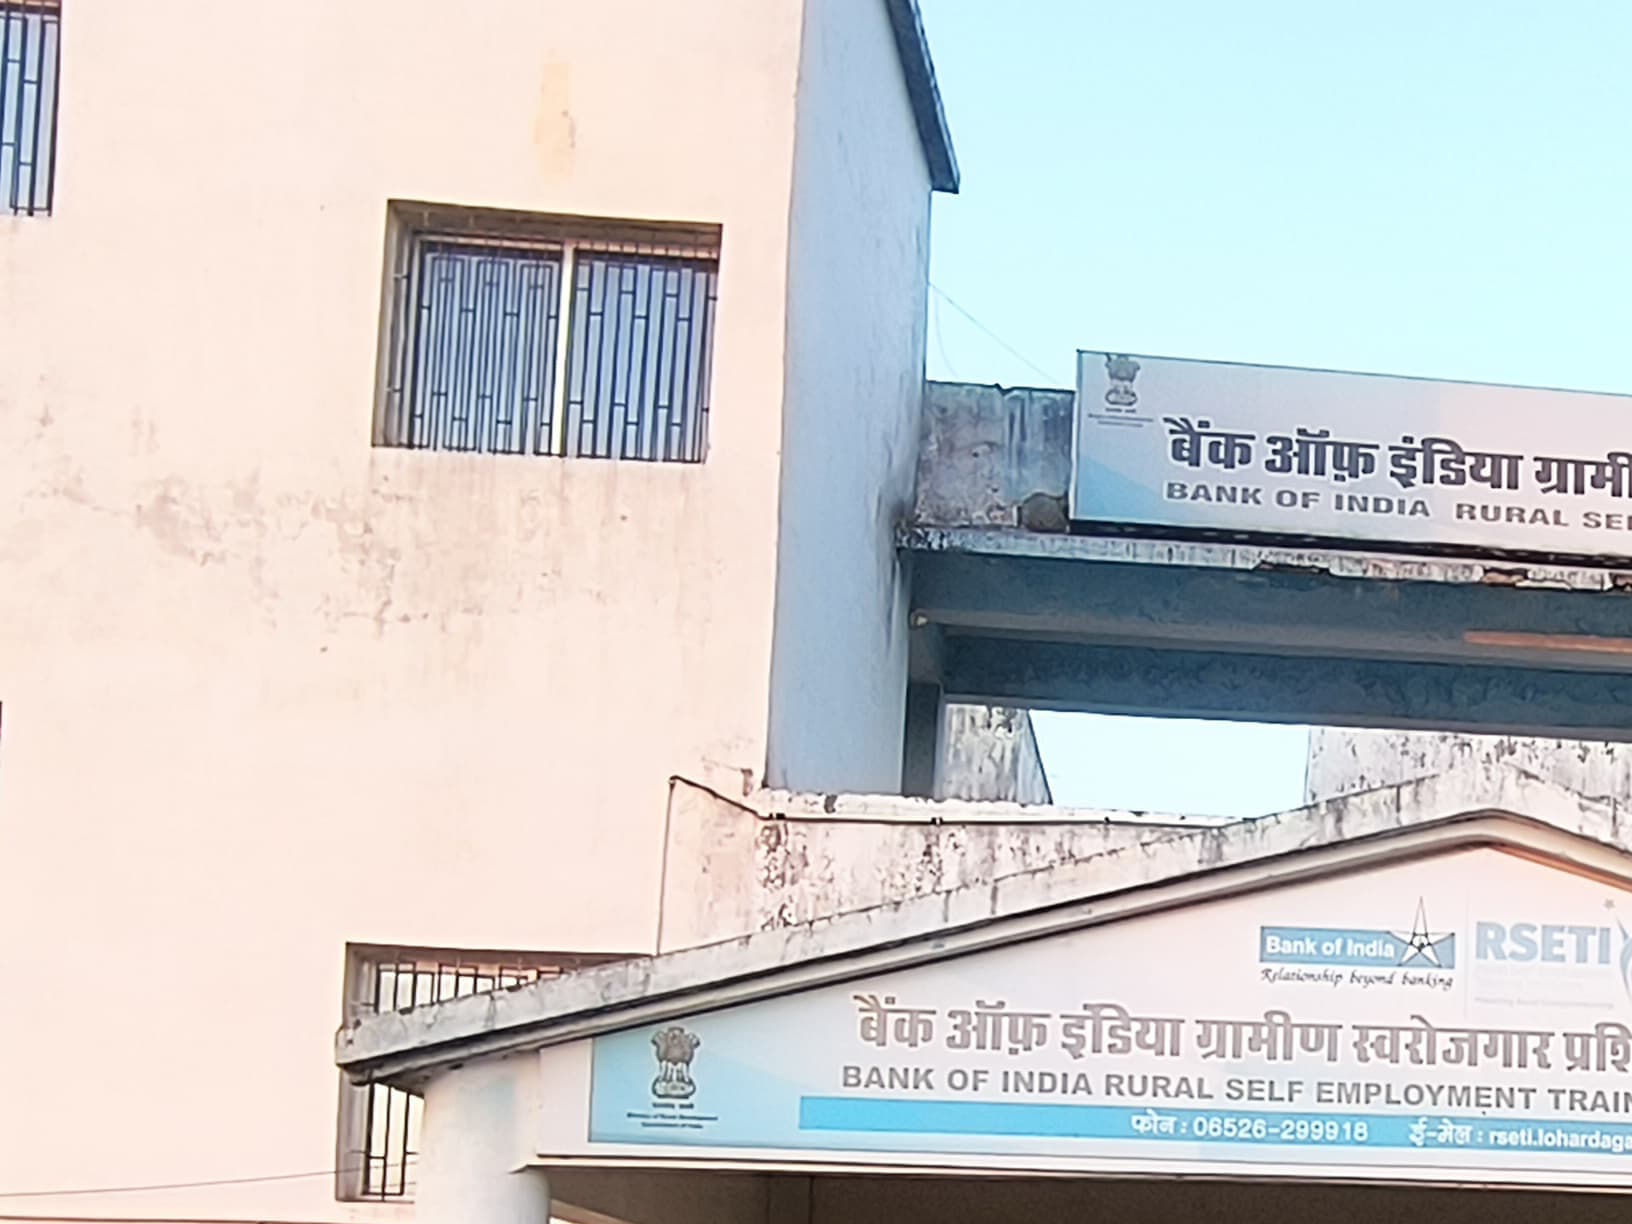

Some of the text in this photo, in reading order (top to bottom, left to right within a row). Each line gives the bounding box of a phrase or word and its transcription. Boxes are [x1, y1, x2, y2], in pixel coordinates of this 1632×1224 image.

[1162, 417, 1255, 469] बैंक
[1265, 428, 1378, 482] ऑफ़
[1390, 435, 1522, 490] इंडिया
[1166, 481, 1262, 506] BANK
[1276, 489, 1319, 509] OF
[1335, 493, 1431, 518] INDIA
[1455, 502, 1570, 527] RURAL
[1266, 935, 1394, 958] Bank of India
[1476, 921, 1610, 964] RSETI
[1261, 968, 1343, 987] Relationship
[1350, 970, 1396, 988] beyond
[1402, 973, 1453, 991] banking
[853, 994, 935, 1048] बैंक
[946, 1000, 1050, 1057] ऑफ़
[1061, 1003, 1183, 1060] इंडिया
[1196, 1010, 1342, 1062] ग्रामीण
[1352, 1015, 1553, 1071] स्वरोजगार
[842, 1065, 937, 1091] BANK
[947, 1067, 990, 1092] OF
[1001, 1069, 1090, 1096] INDIA
[1105, 1073, 1214, 1100] RURAL
[1225, 1078, 1303, 1103] SELF
[1316, 1081, 1536, 1110] EMPLOYMENT
[1193, 1116, 1368, 1141] 06526-299918
